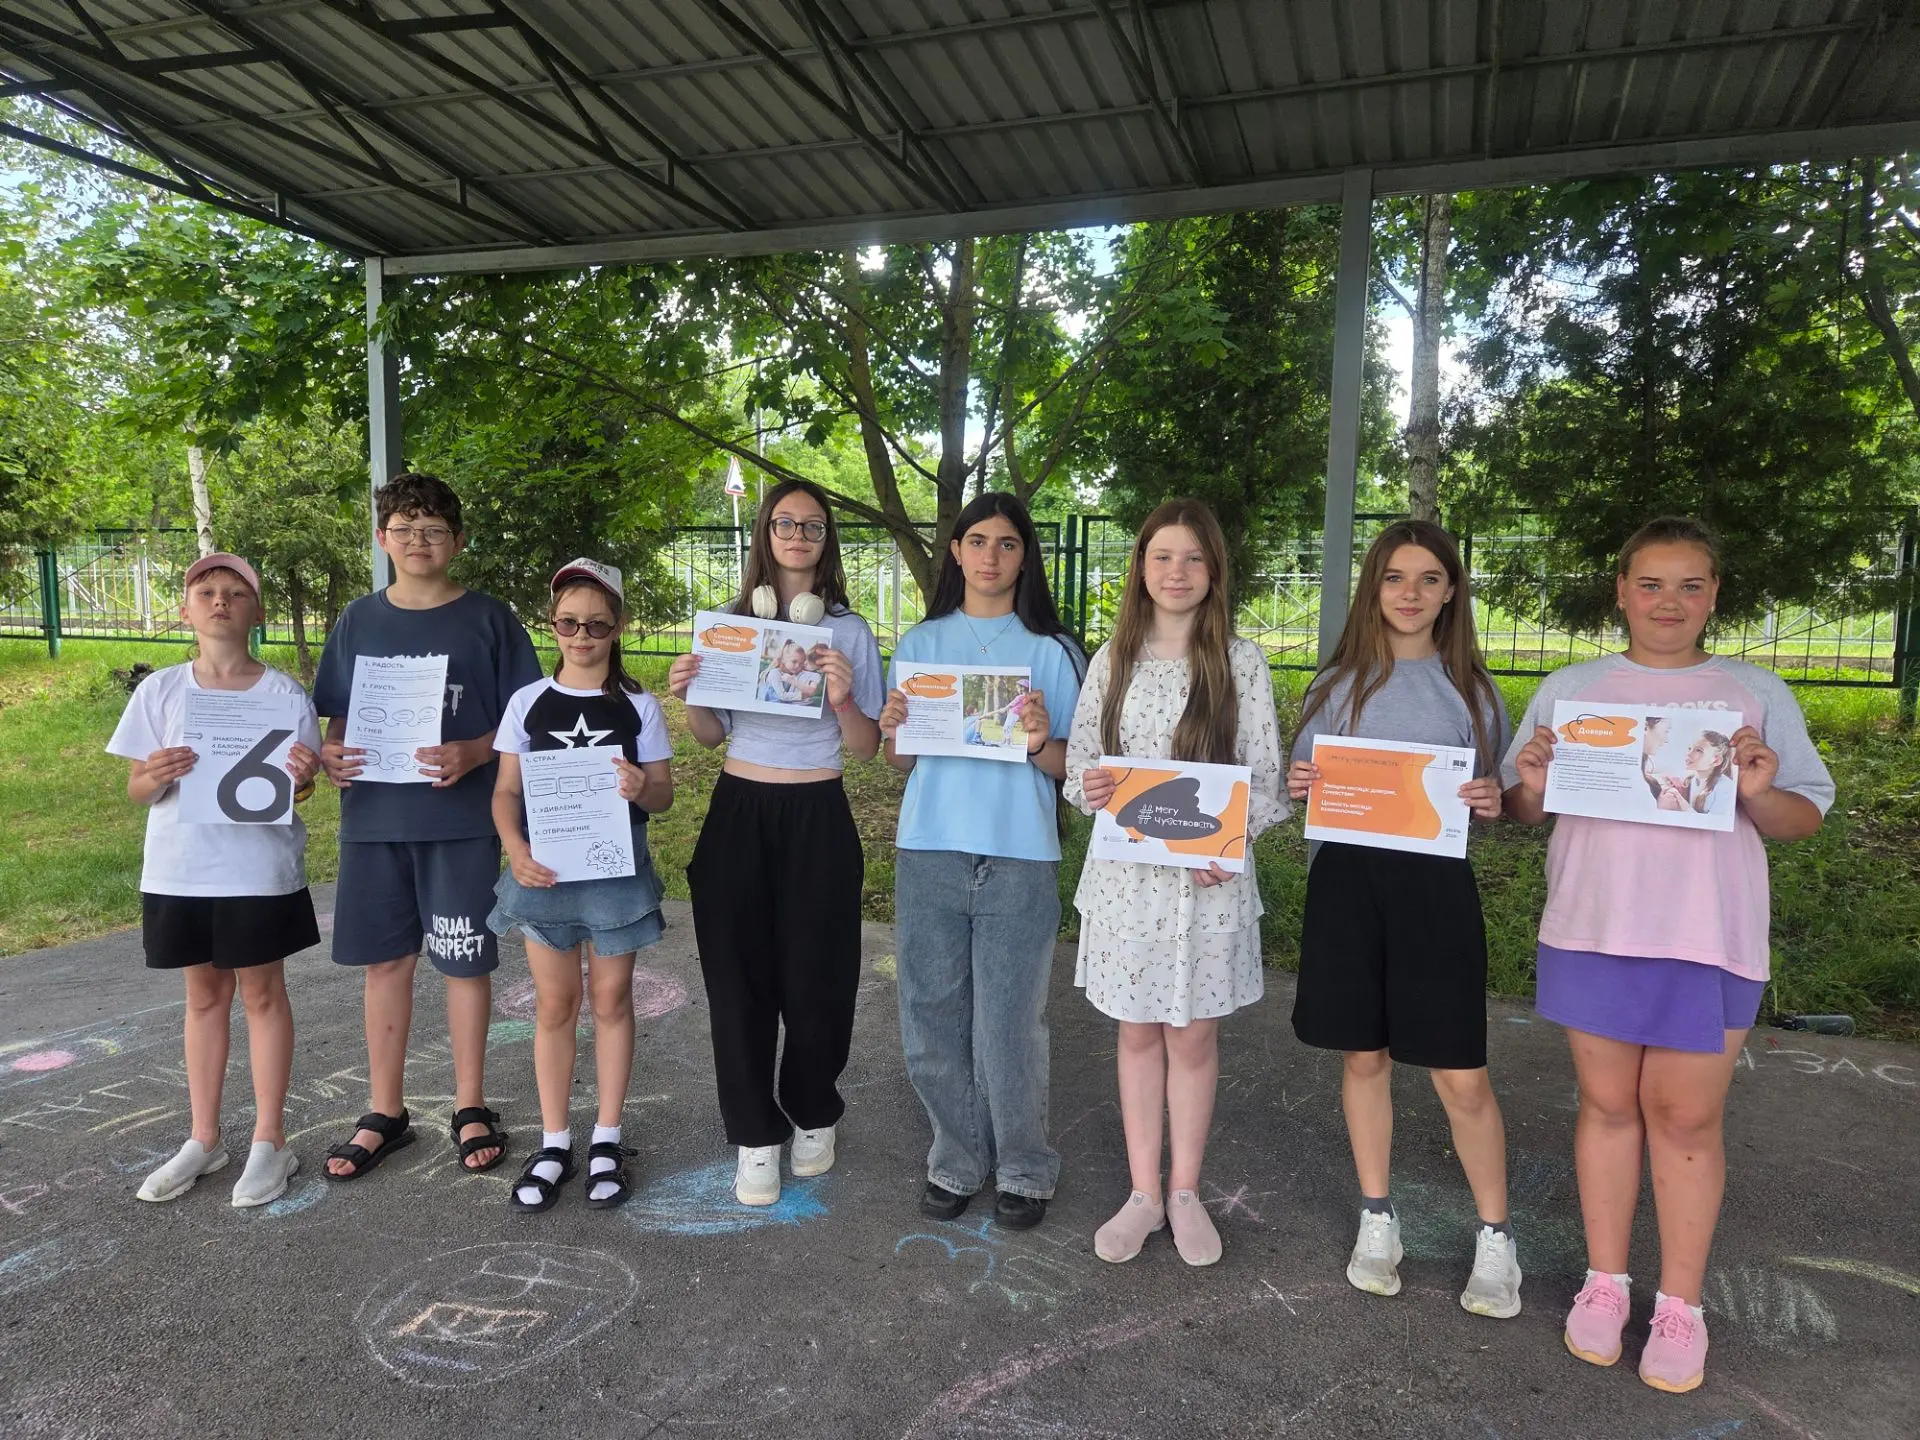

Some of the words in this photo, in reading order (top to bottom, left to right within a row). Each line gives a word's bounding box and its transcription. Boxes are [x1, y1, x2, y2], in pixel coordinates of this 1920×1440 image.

[372, 661, 404, 669] РАДОСТЬ
[369, 683, 396, 691] ГРУСТЬ
[1577, 727, 1614, 736] Доверие
[532, 755, 557, 763] СТРАХ
[217, 729, 295, 823] 6
[539, 804, 583, 813] УДИВЛЕНИЕ
[1155, 805, 1179, 817] Могу
[1154, 816, 1216, 829] Чувствовать
[542, 825, 591, 835] ОТВРАЩЕНИЕ
[432, 914, 475, 938] USUAL
[426, 932, 485, 962] SUSPECT
